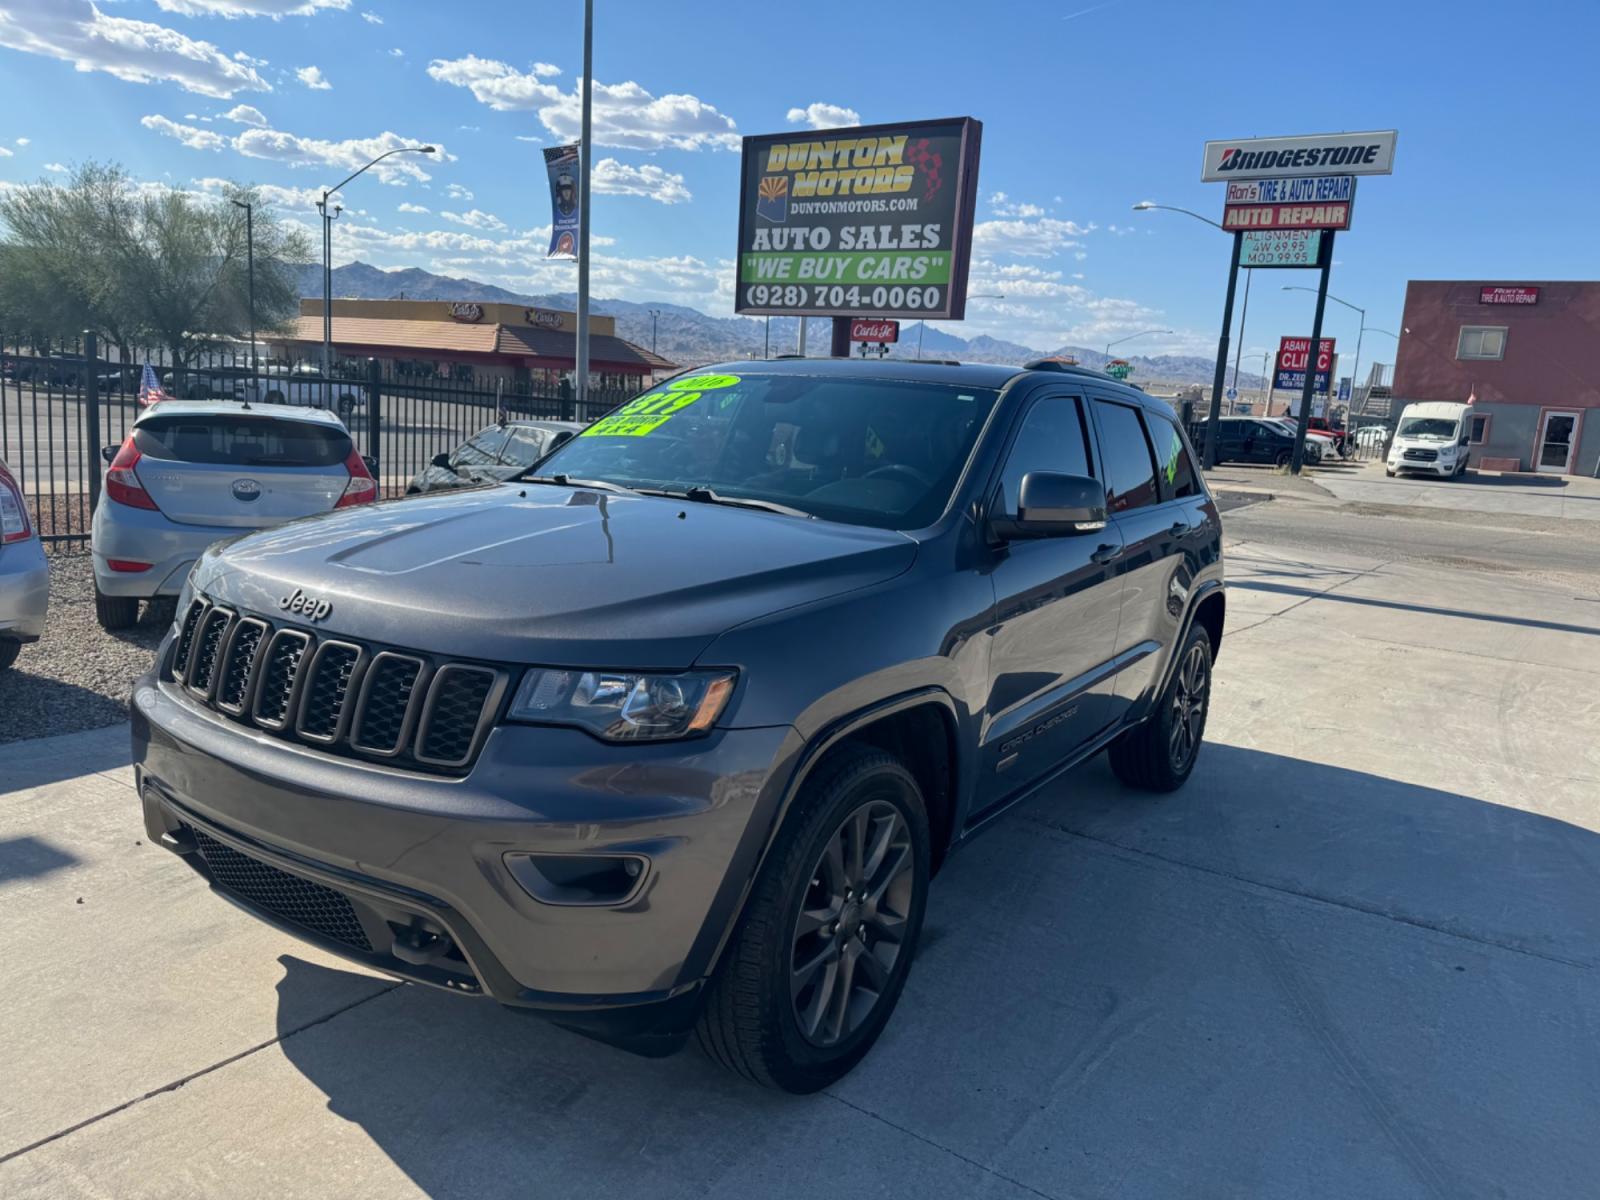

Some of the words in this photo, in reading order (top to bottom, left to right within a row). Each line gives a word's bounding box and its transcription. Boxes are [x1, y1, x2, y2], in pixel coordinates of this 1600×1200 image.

[767, 136, 908, 172] DUNTON
[1217, 145, 1380, 171] BRIDGESTONE
[792, 165, 914, 197] MOTORS
[1229, 184, 1257, 199] Ron's
[1257, 181, 1278, 200] TIRE
[1279, 181, 1287, 199] &
[1289, 179, 1314, 199] AUTO
[1316, 177, 1350, 199] REPAIR
[790, 199, 918, 215] DUNTONMOTORS.COM
[1225, 208, 1273, 225] AUTO
[1278, 206, 1346, 224] REPAIR
[752, 227, 831, 251] AUTO
[839, 224, 941, 249] SALES
[747, 257, 793, 279] "WE
[798, 257, 851, 279] BUY
[857, 257, 944, 280] CARS"
[746, 284, 808, 306] (928)
[814, 285, 941, 309] 704-0060
[1283, 340, 1306, 351] ABAN
[1281, 352, 1328, 369] CLIC
[280, 588, 332, 622] Jeep
